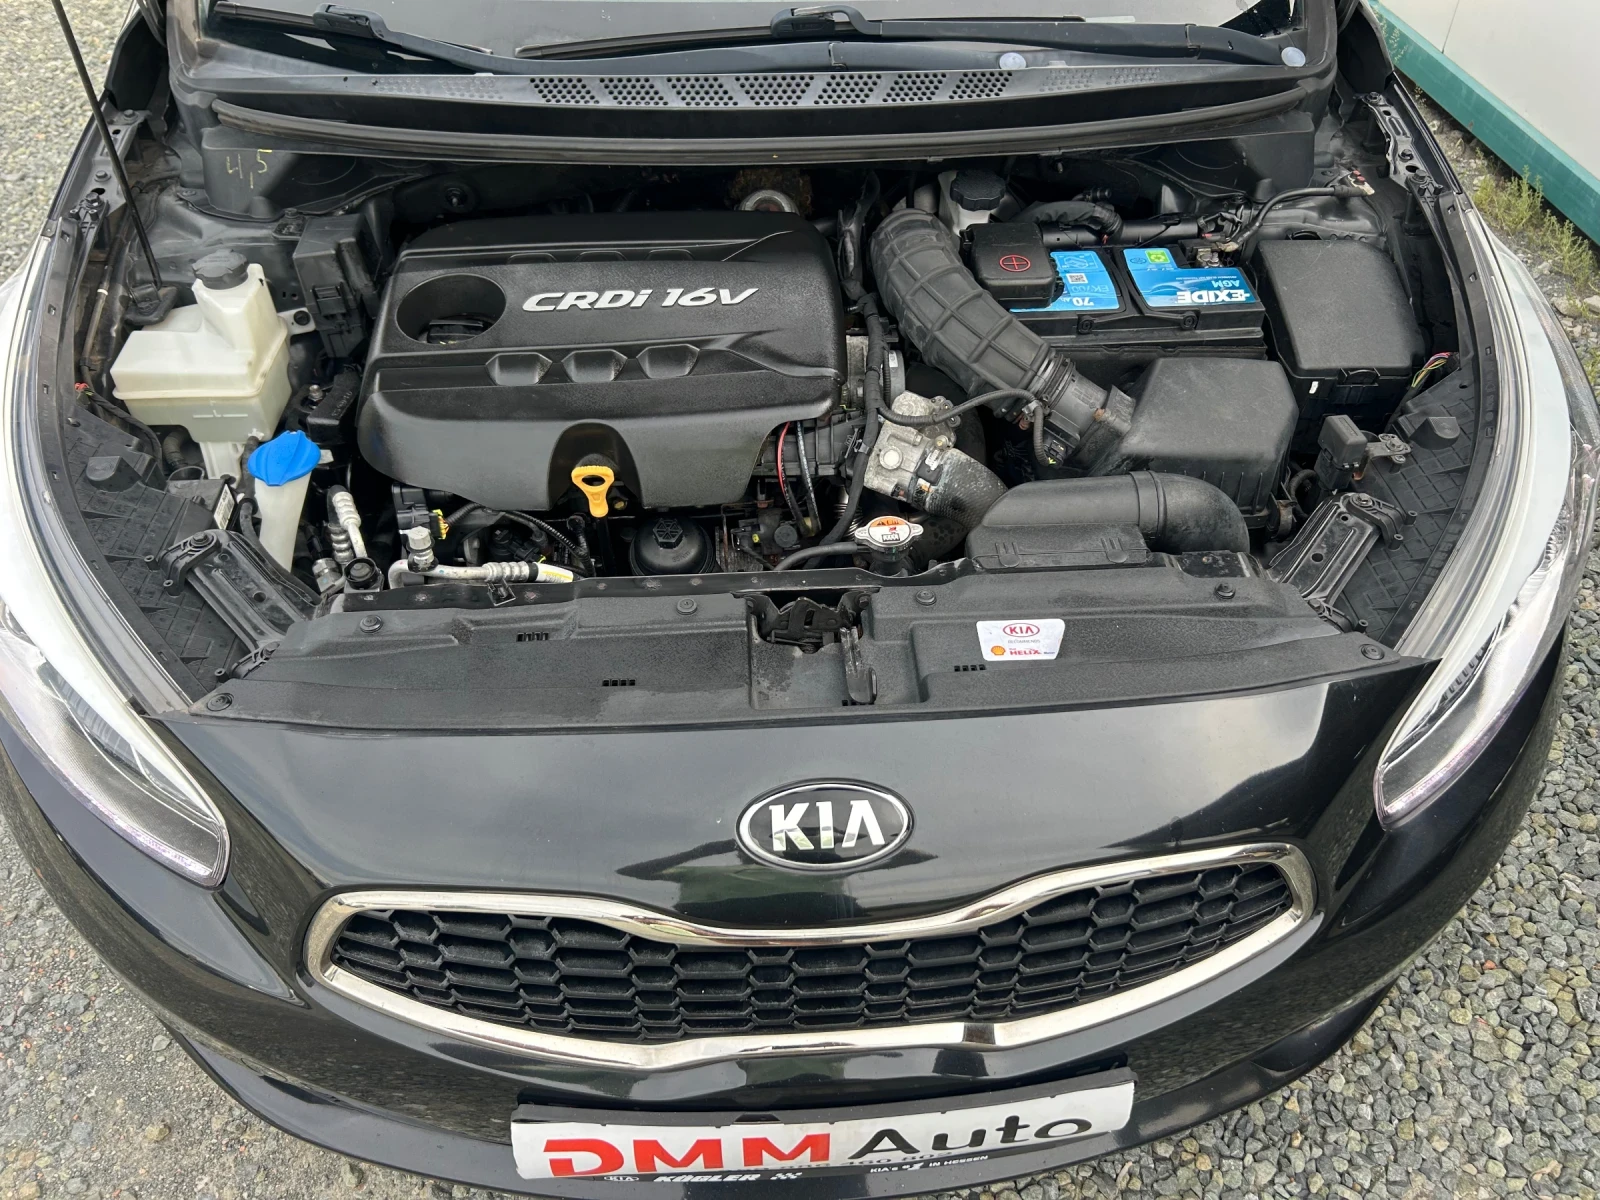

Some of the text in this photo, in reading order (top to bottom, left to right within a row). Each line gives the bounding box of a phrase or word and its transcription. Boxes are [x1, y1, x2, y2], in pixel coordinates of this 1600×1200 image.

[1211, 279, 1240, 289] AGM
[522, 287, 760, 312] CRDi 16V
[1072, 296, 1095, 307] 70
[1176, 289, 1250, 304] EXIDE
[1009, 626, 1034, 635] KIA
[768, 799, 886, 852] KIA
[543, 1114, 1093, 1177] DMM Auto
